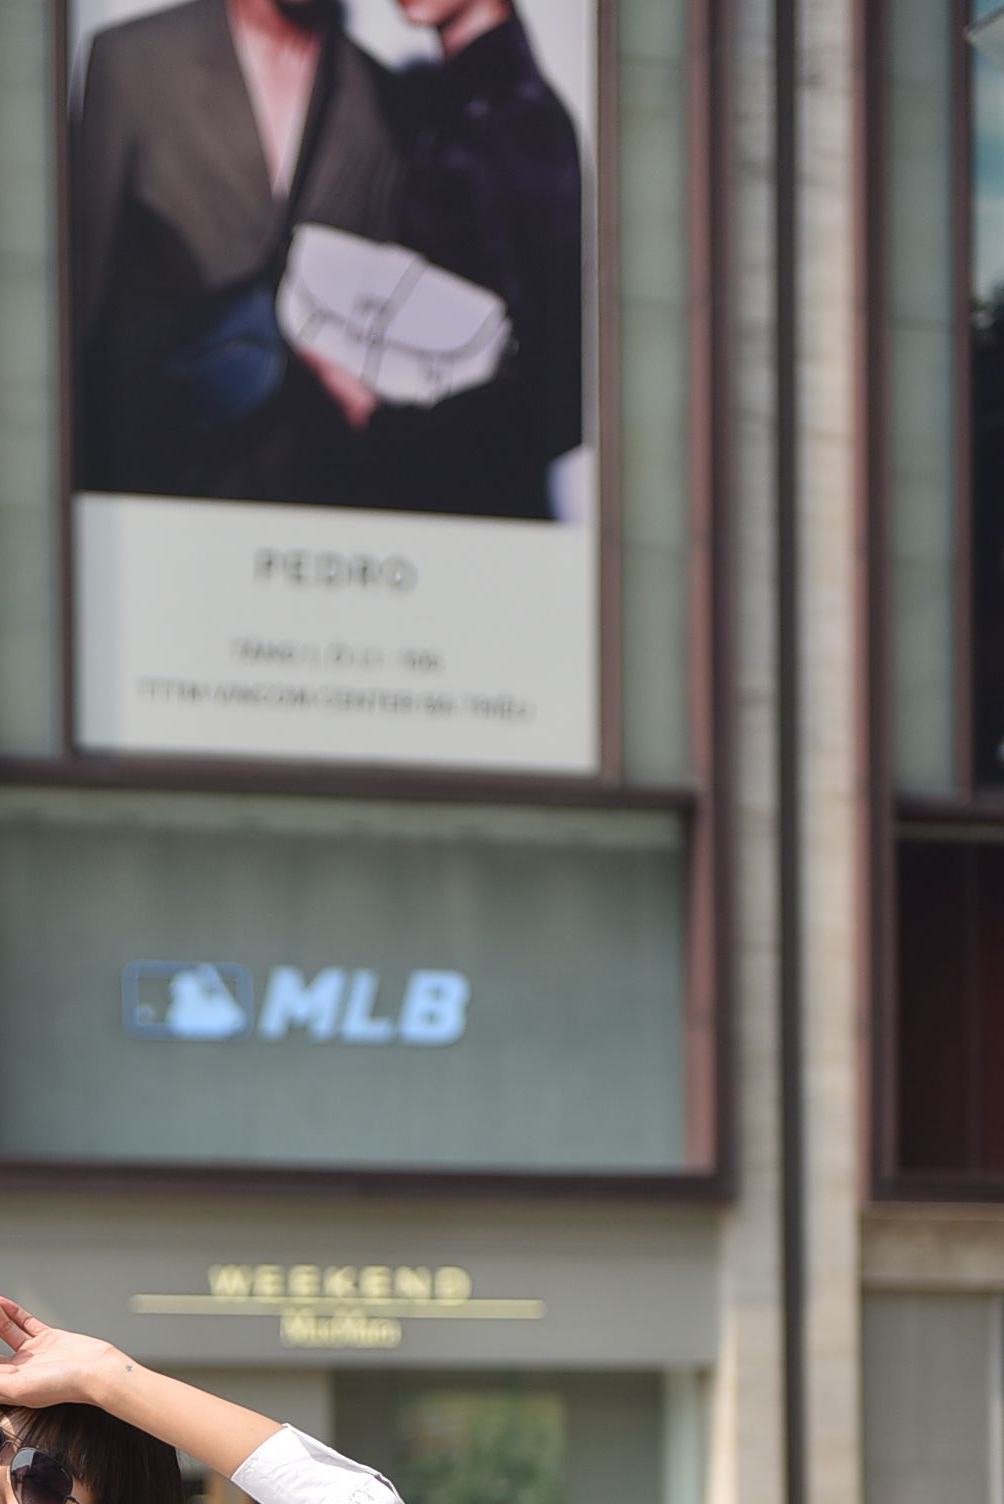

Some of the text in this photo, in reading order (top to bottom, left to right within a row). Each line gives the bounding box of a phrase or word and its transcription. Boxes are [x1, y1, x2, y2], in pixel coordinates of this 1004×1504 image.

[256, 549, 416, 596] PEDRO
[259, 966, 469, 1045] MLB
[209, 1265, 470, 1303] WEEKEND
